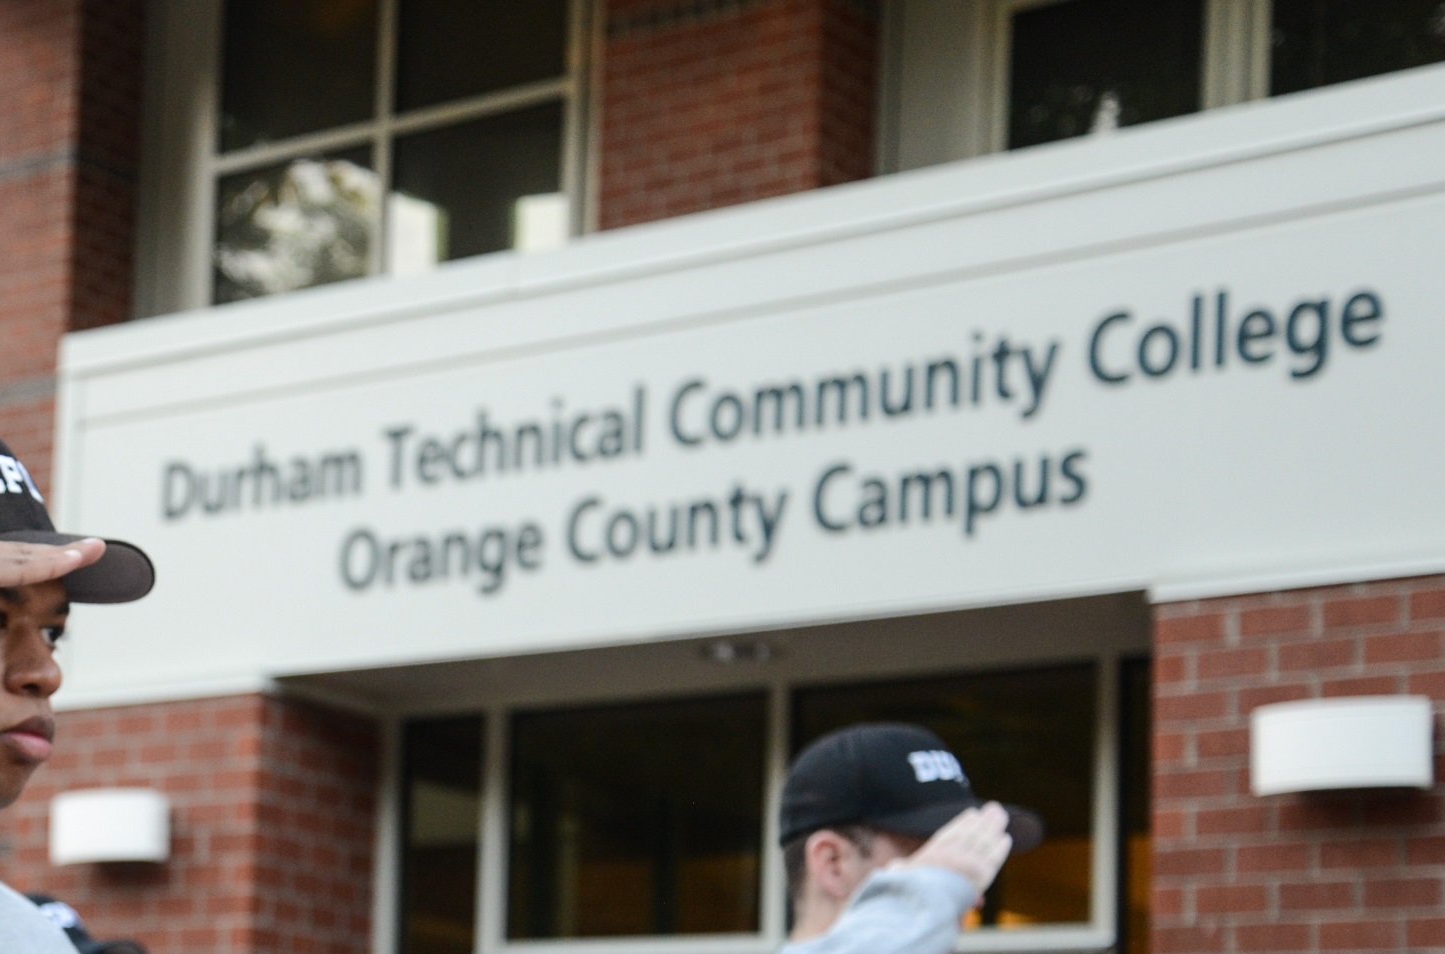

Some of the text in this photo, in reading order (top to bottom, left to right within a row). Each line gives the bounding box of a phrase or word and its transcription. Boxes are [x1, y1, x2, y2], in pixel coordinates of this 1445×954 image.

[161, 288, 1386, 521] Durham Technical Community College
[339, 446, 1090, 597] Orange County Campus
